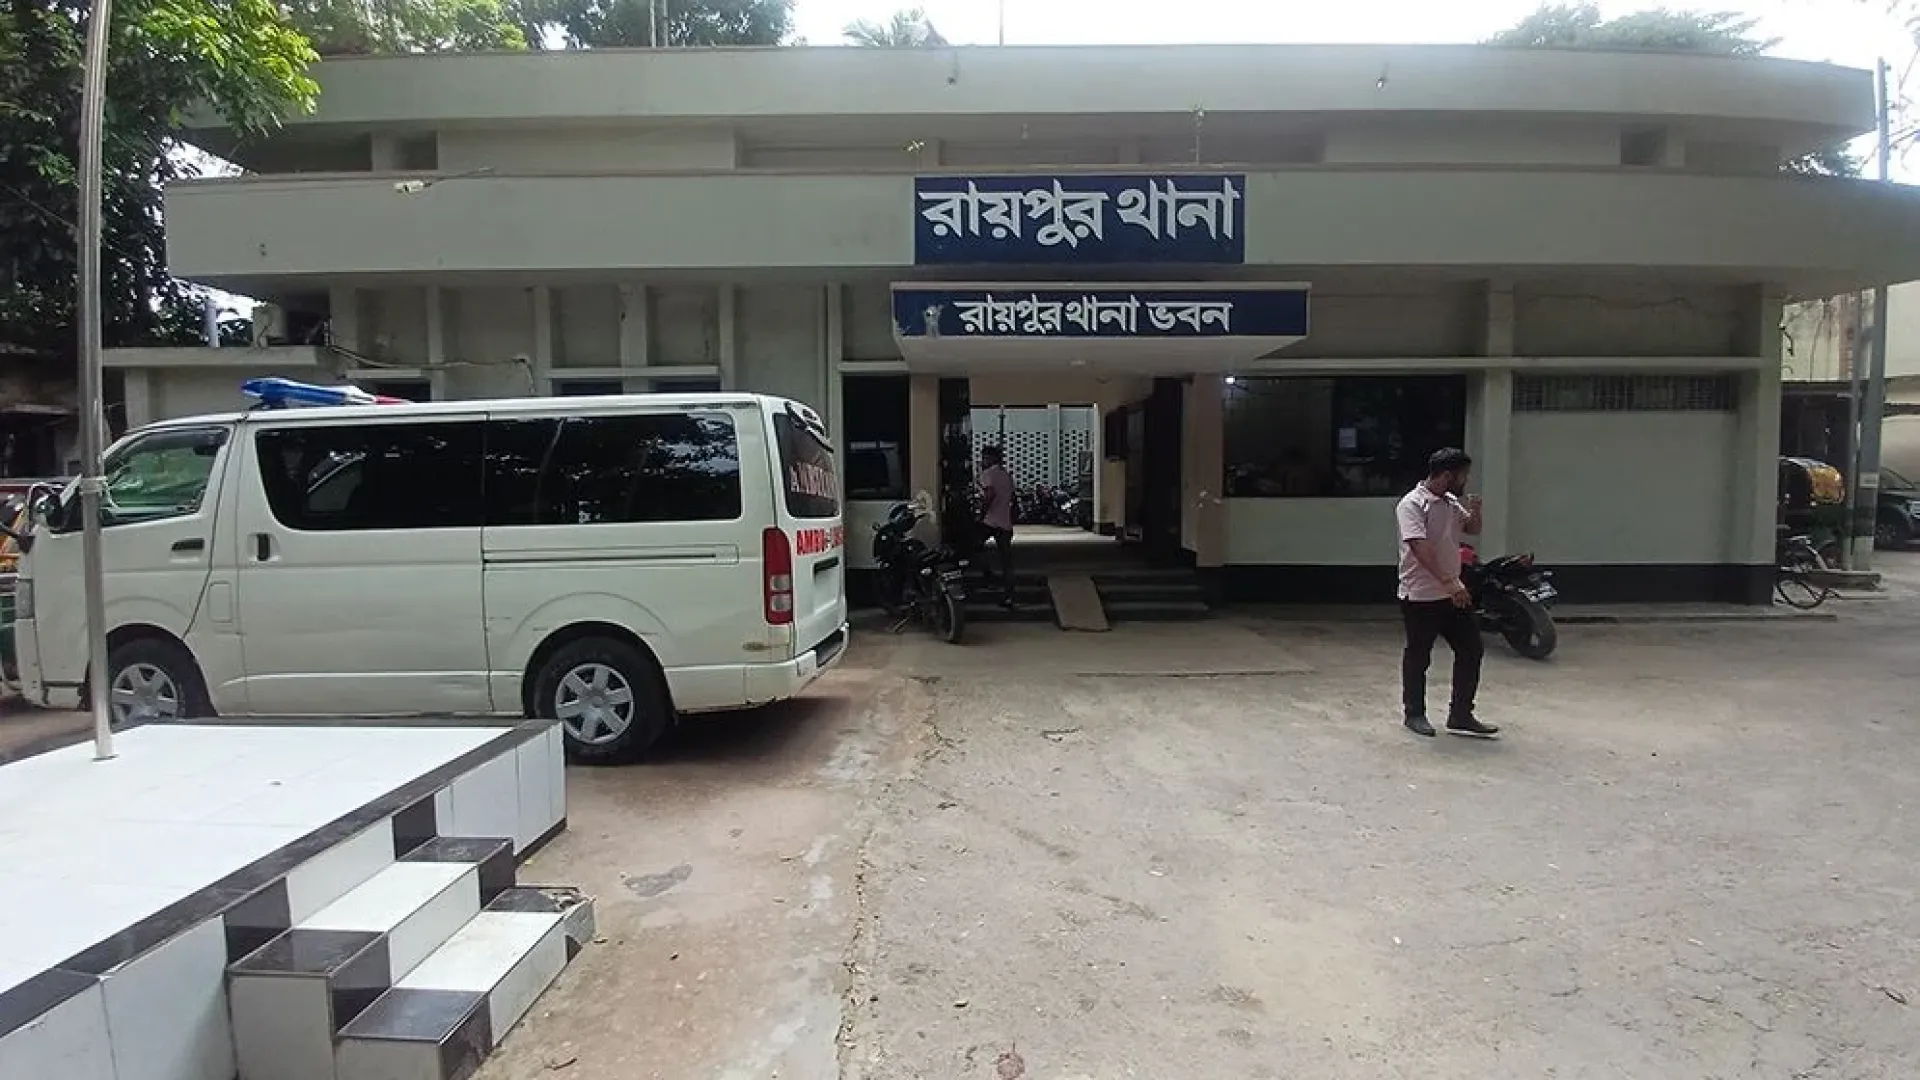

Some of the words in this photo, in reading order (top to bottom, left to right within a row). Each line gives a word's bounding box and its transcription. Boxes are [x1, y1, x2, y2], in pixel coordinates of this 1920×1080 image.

[918, 179, 1110, 249] রায়পুর
[1116, 177, 1242, 241] থানা
[1146, 301, 1234, 333] ভবন
